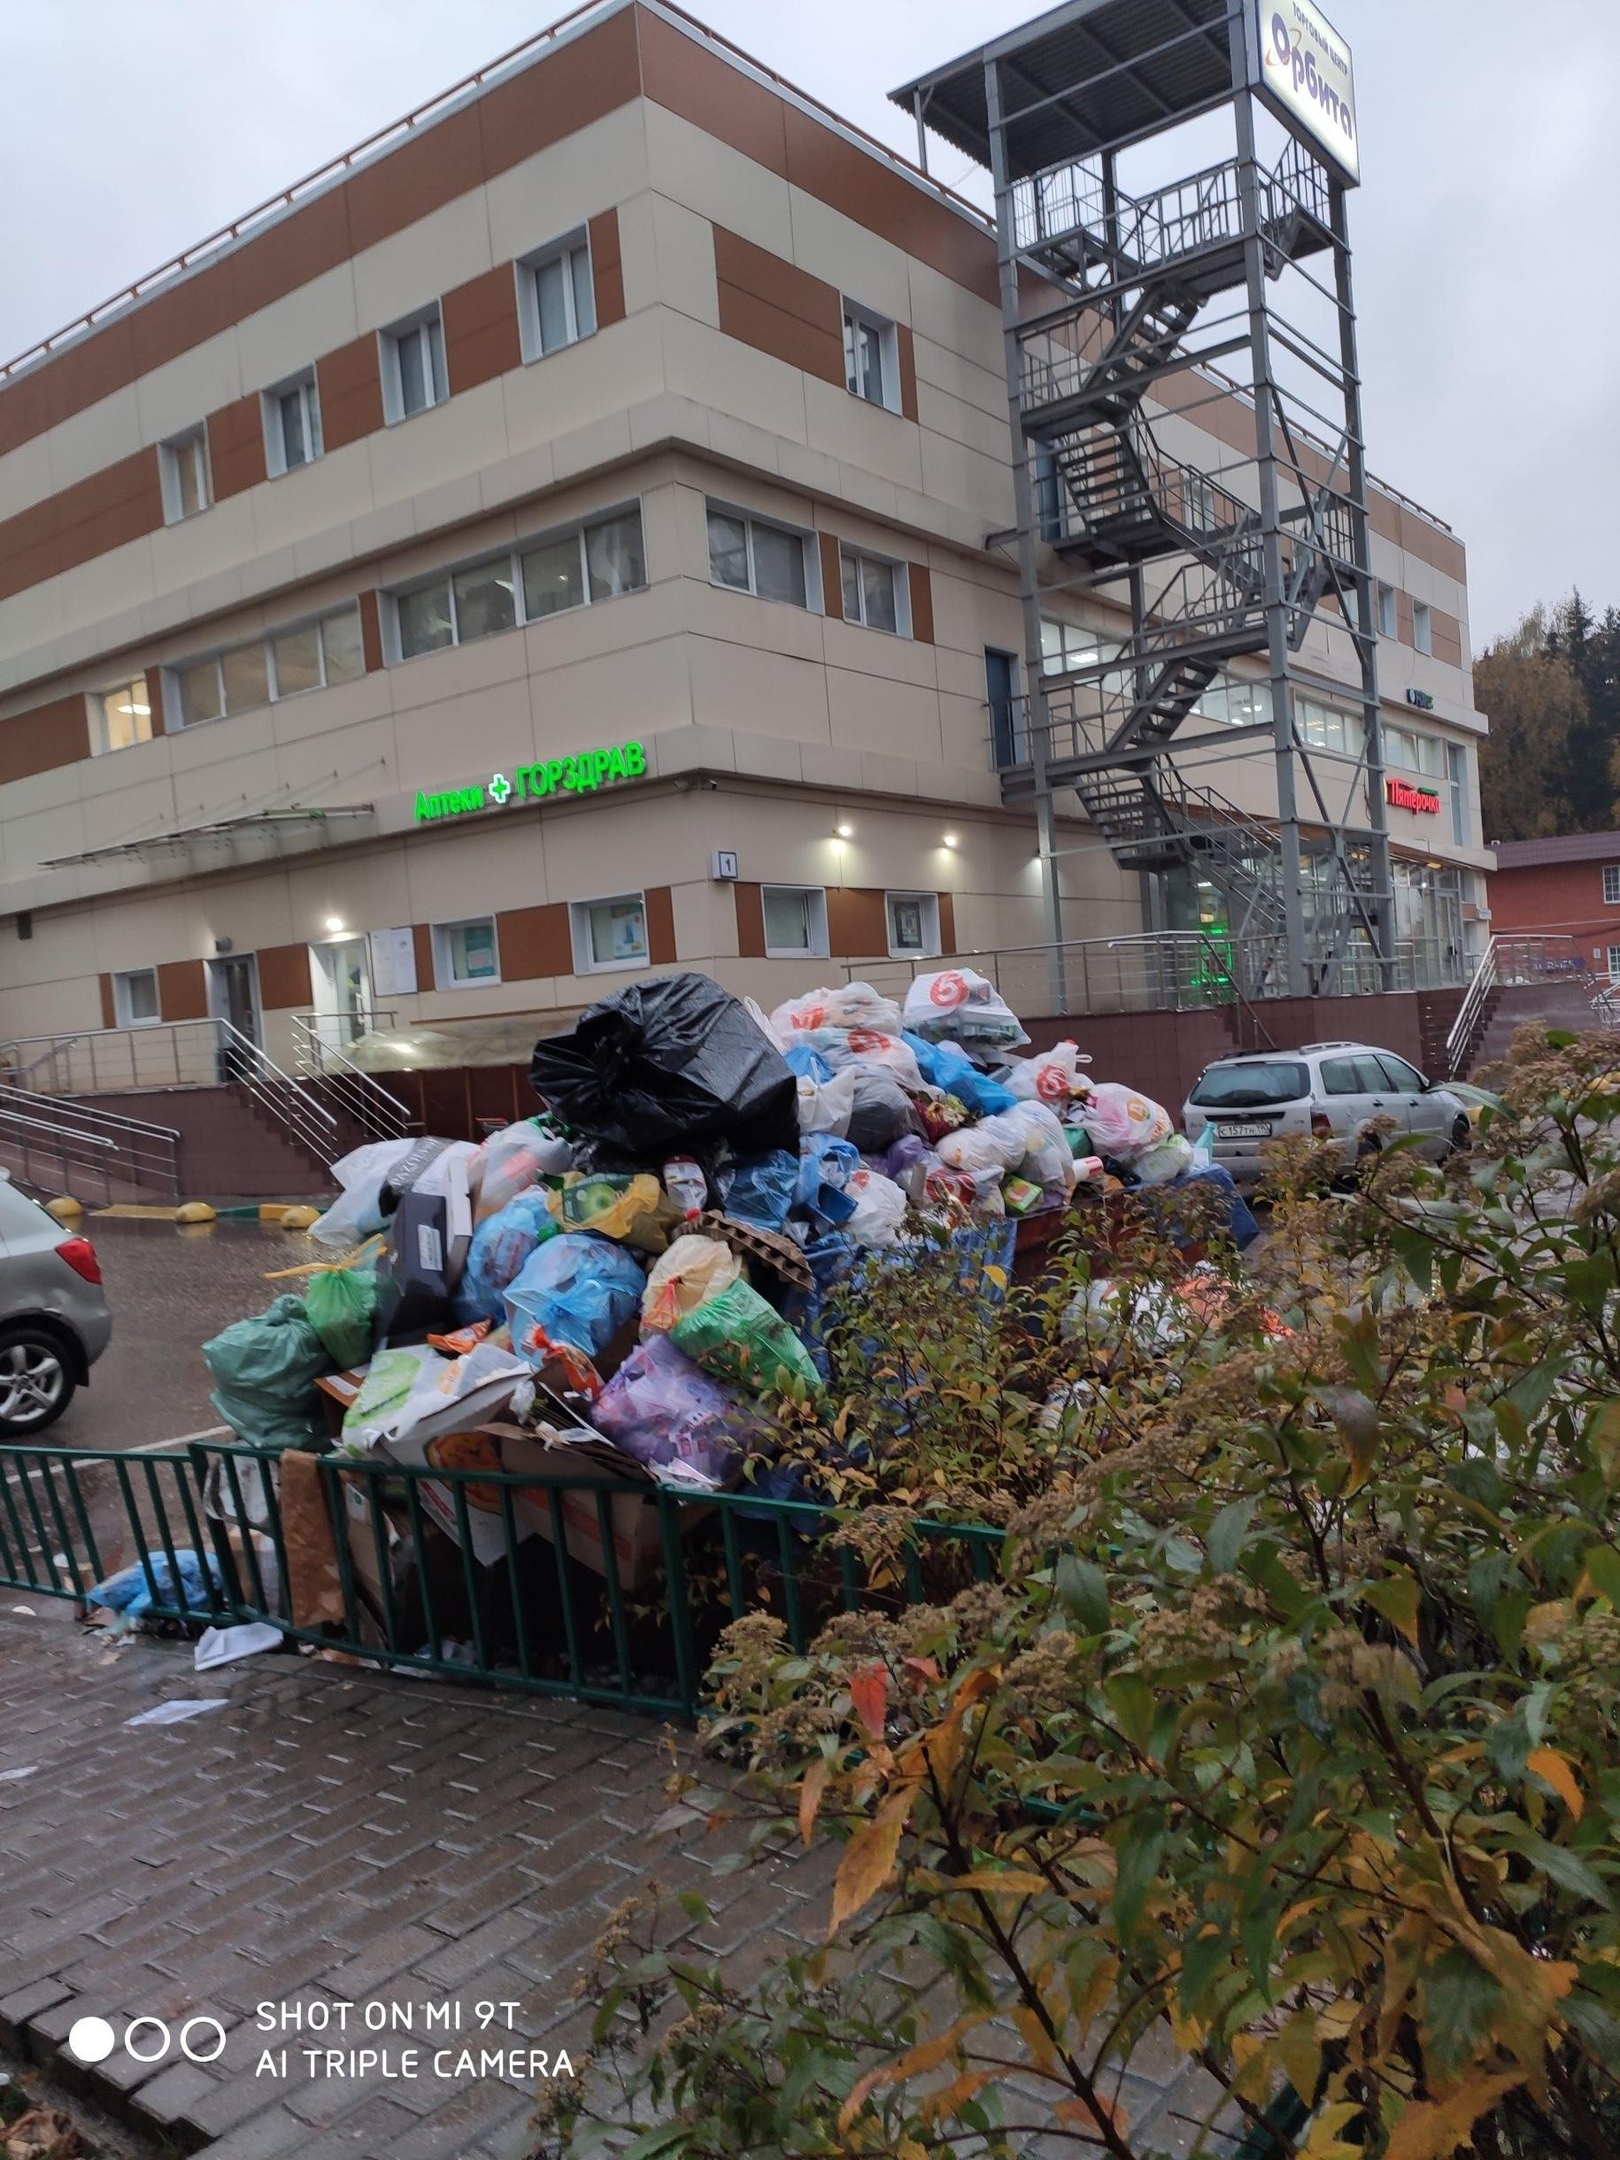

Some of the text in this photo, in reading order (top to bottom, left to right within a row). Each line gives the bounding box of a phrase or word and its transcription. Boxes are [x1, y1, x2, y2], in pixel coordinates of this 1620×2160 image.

[1271, 12, 1353, 141] Орбита
[415, 741, 646, 822] Аптеки ГОРЗДРАВ
